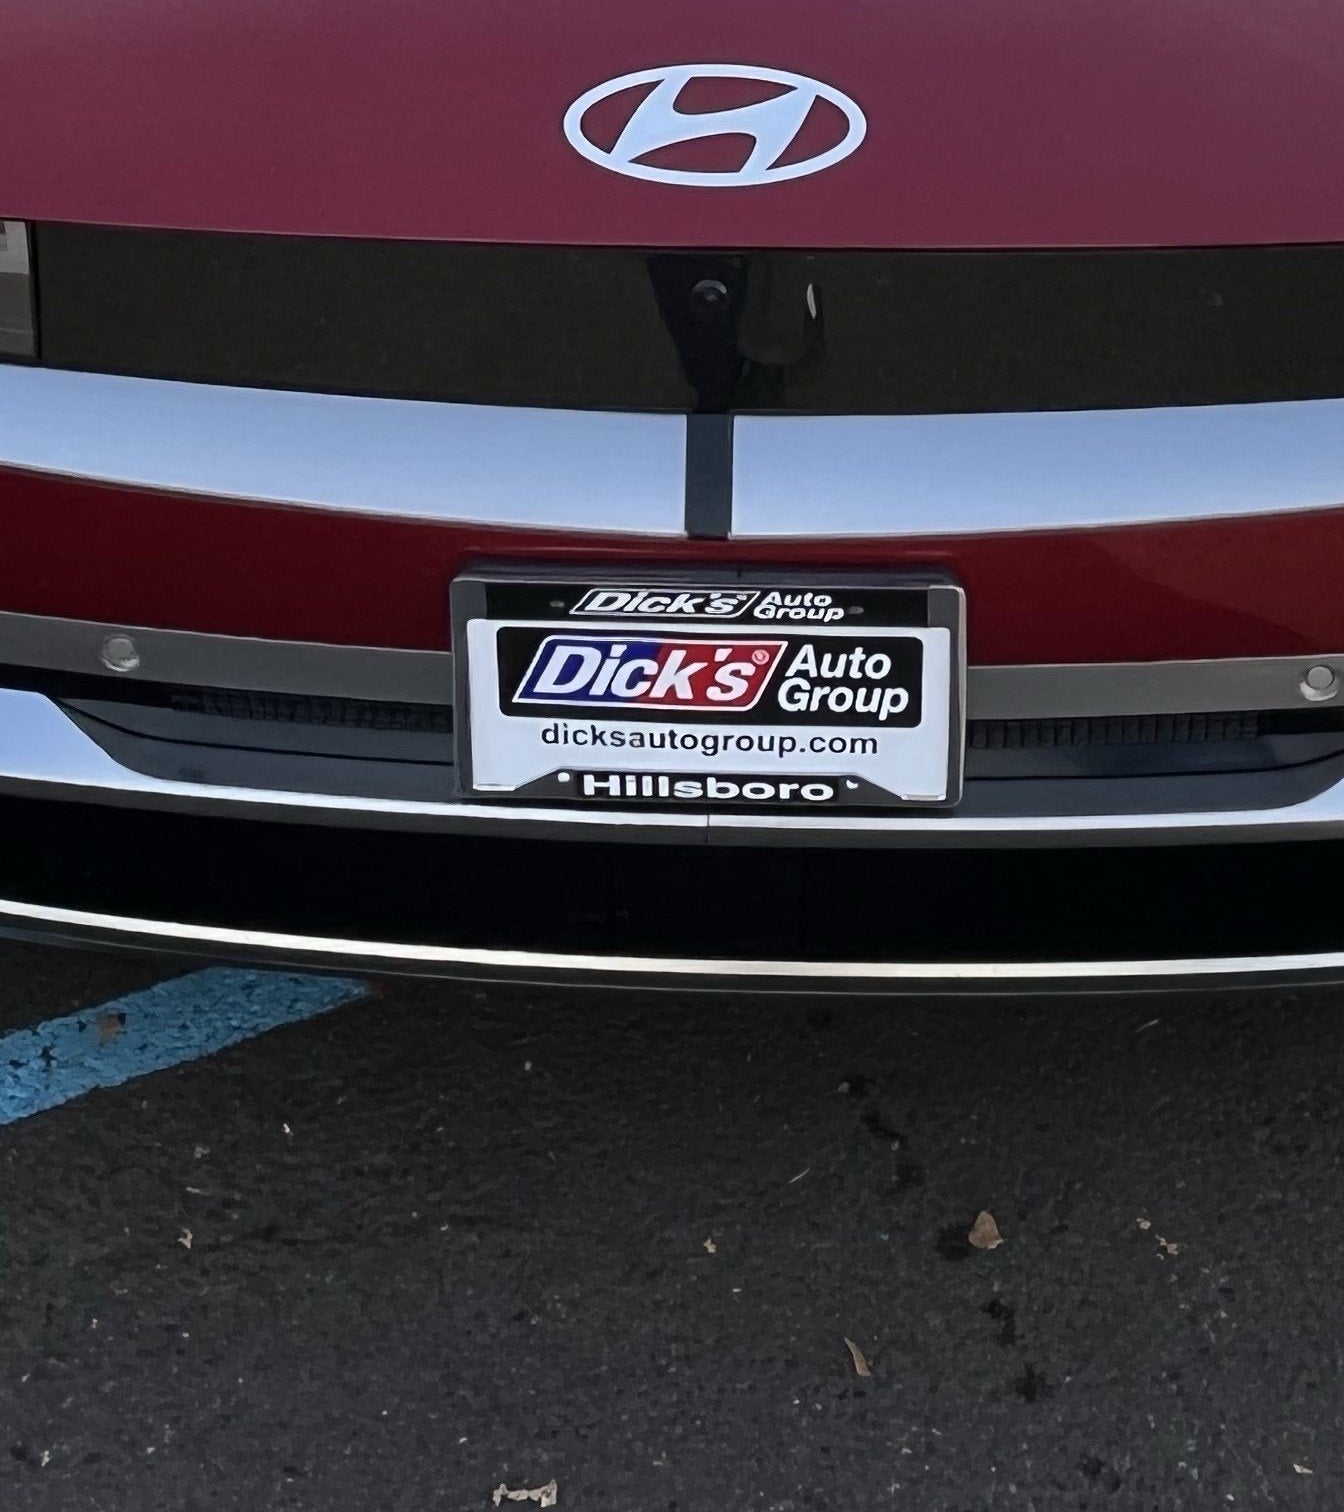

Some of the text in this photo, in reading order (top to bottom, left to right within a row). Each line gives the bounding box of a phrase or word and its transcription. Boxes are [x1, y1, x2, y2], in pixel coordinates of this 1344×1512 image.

[753, 605, 845, 623] Group
[761, 591, 833, 608] Auto
[533, 643, 747, 702] Dick's
[784, 644, 892, 680] Auto
[777, 678, 910, 721] Group
[540, 722, 879, 757] dicksautogroup.com
[582, 773, 835, 802] Hillsboro
